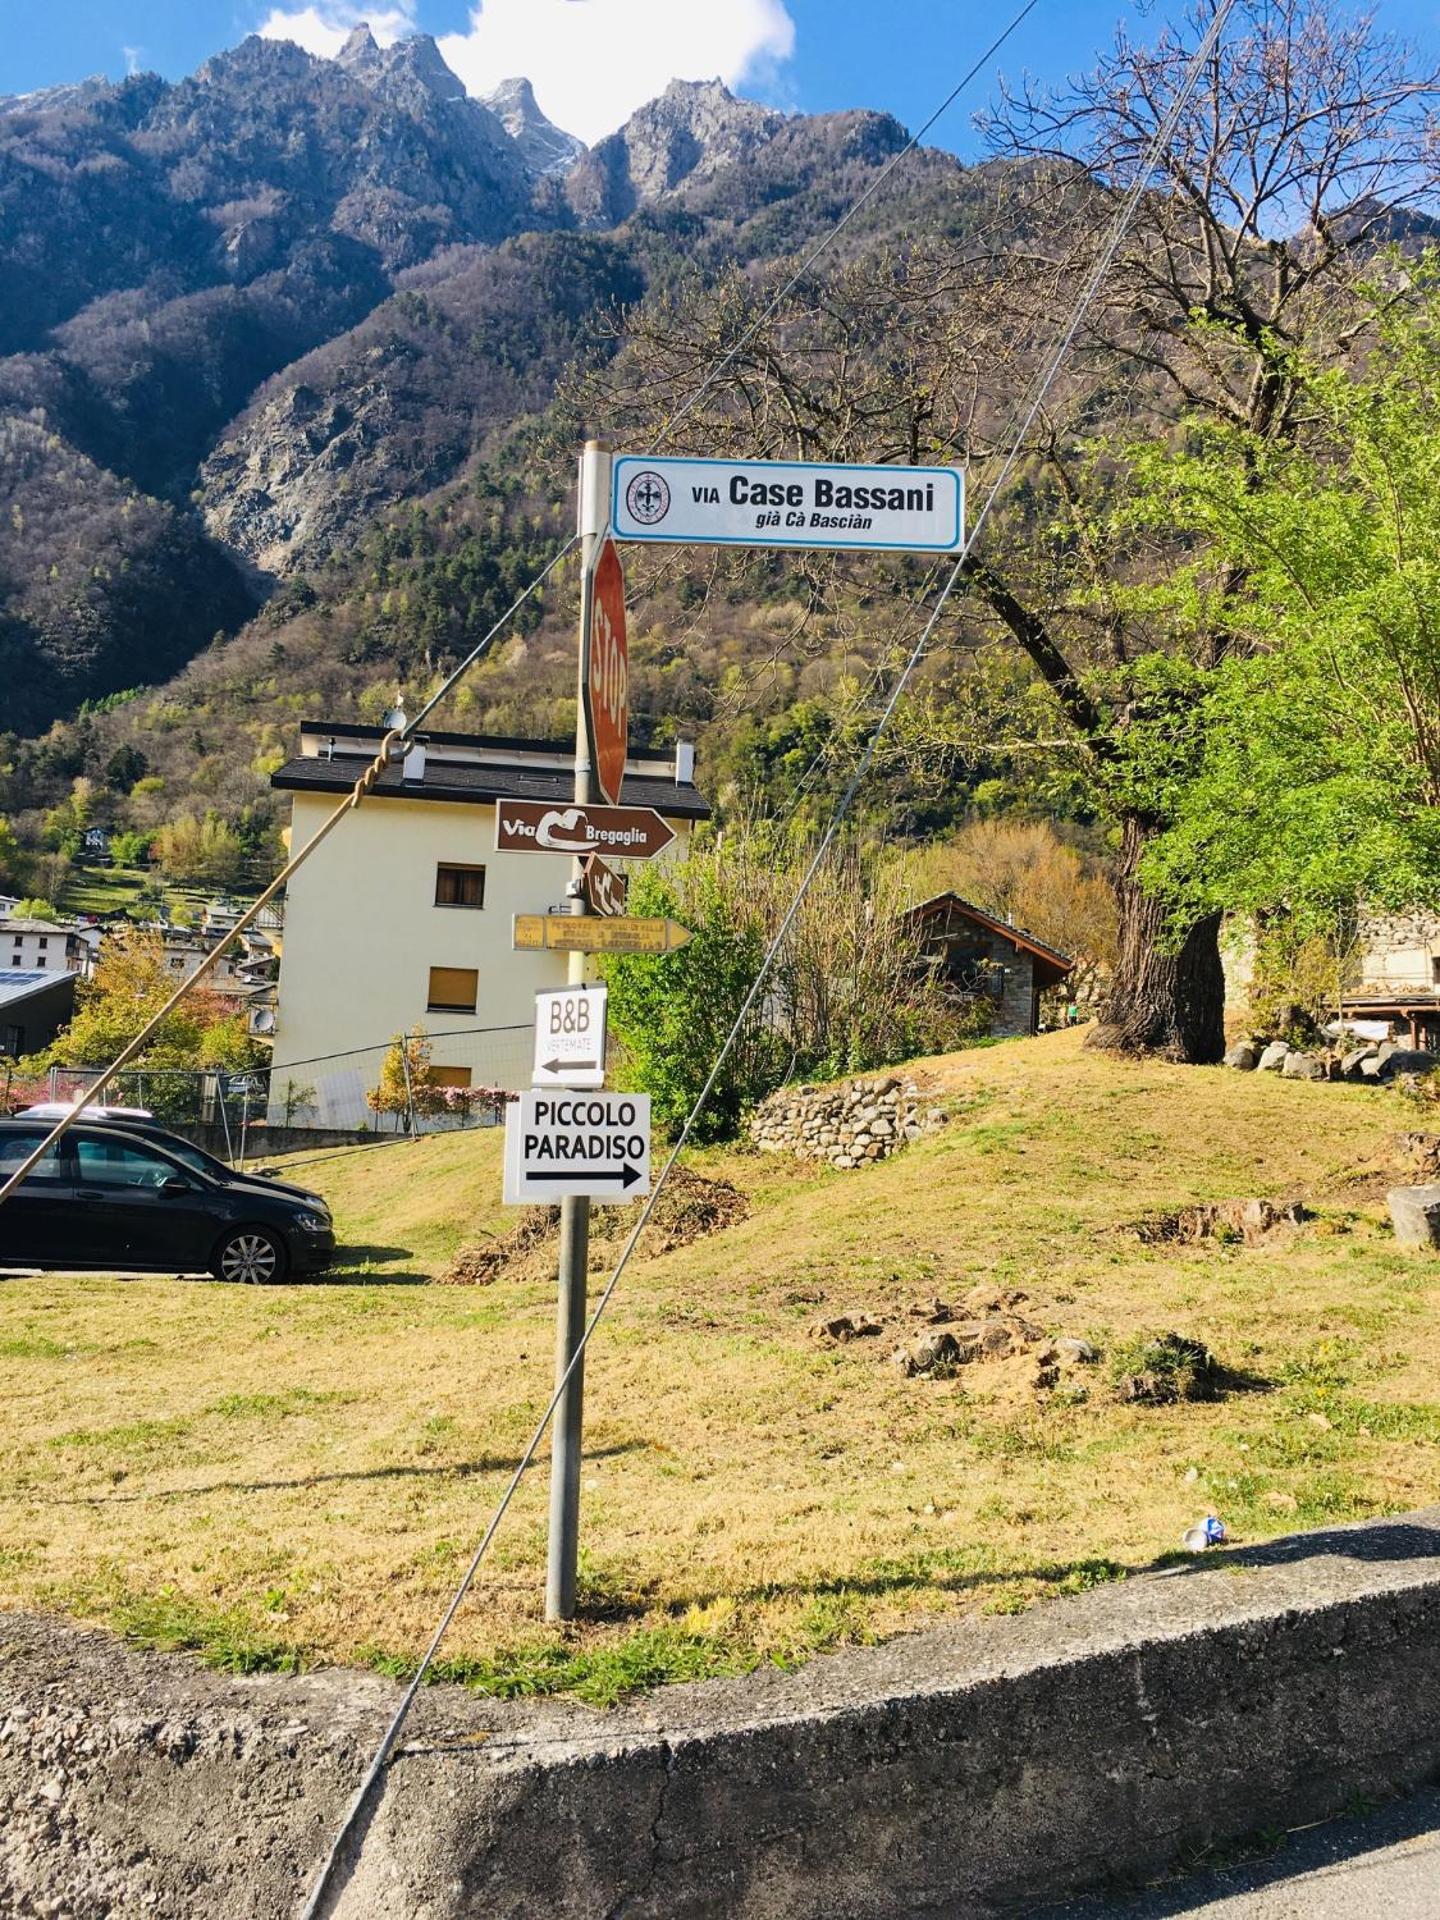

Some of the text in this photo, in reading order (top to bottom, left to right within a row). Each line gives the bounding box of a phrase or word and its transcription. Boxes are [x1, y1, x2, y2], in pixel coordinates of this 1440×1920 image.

[691, 486, 720, 504] VIA
[729, 475, 804, 506] Case
[814, 479, 934, 512] Bassani
[756, 511, 873, 530] già Cà Basciàn
[593, 597, 627, 739] STOP
[503, 819, 648, 846] Via Bregaglia
[550, 998, 590, 1034] B&B
[534, 1101, 636, 1127] PICCOLO
[524, 1134, 645, 1160] PARADISO
